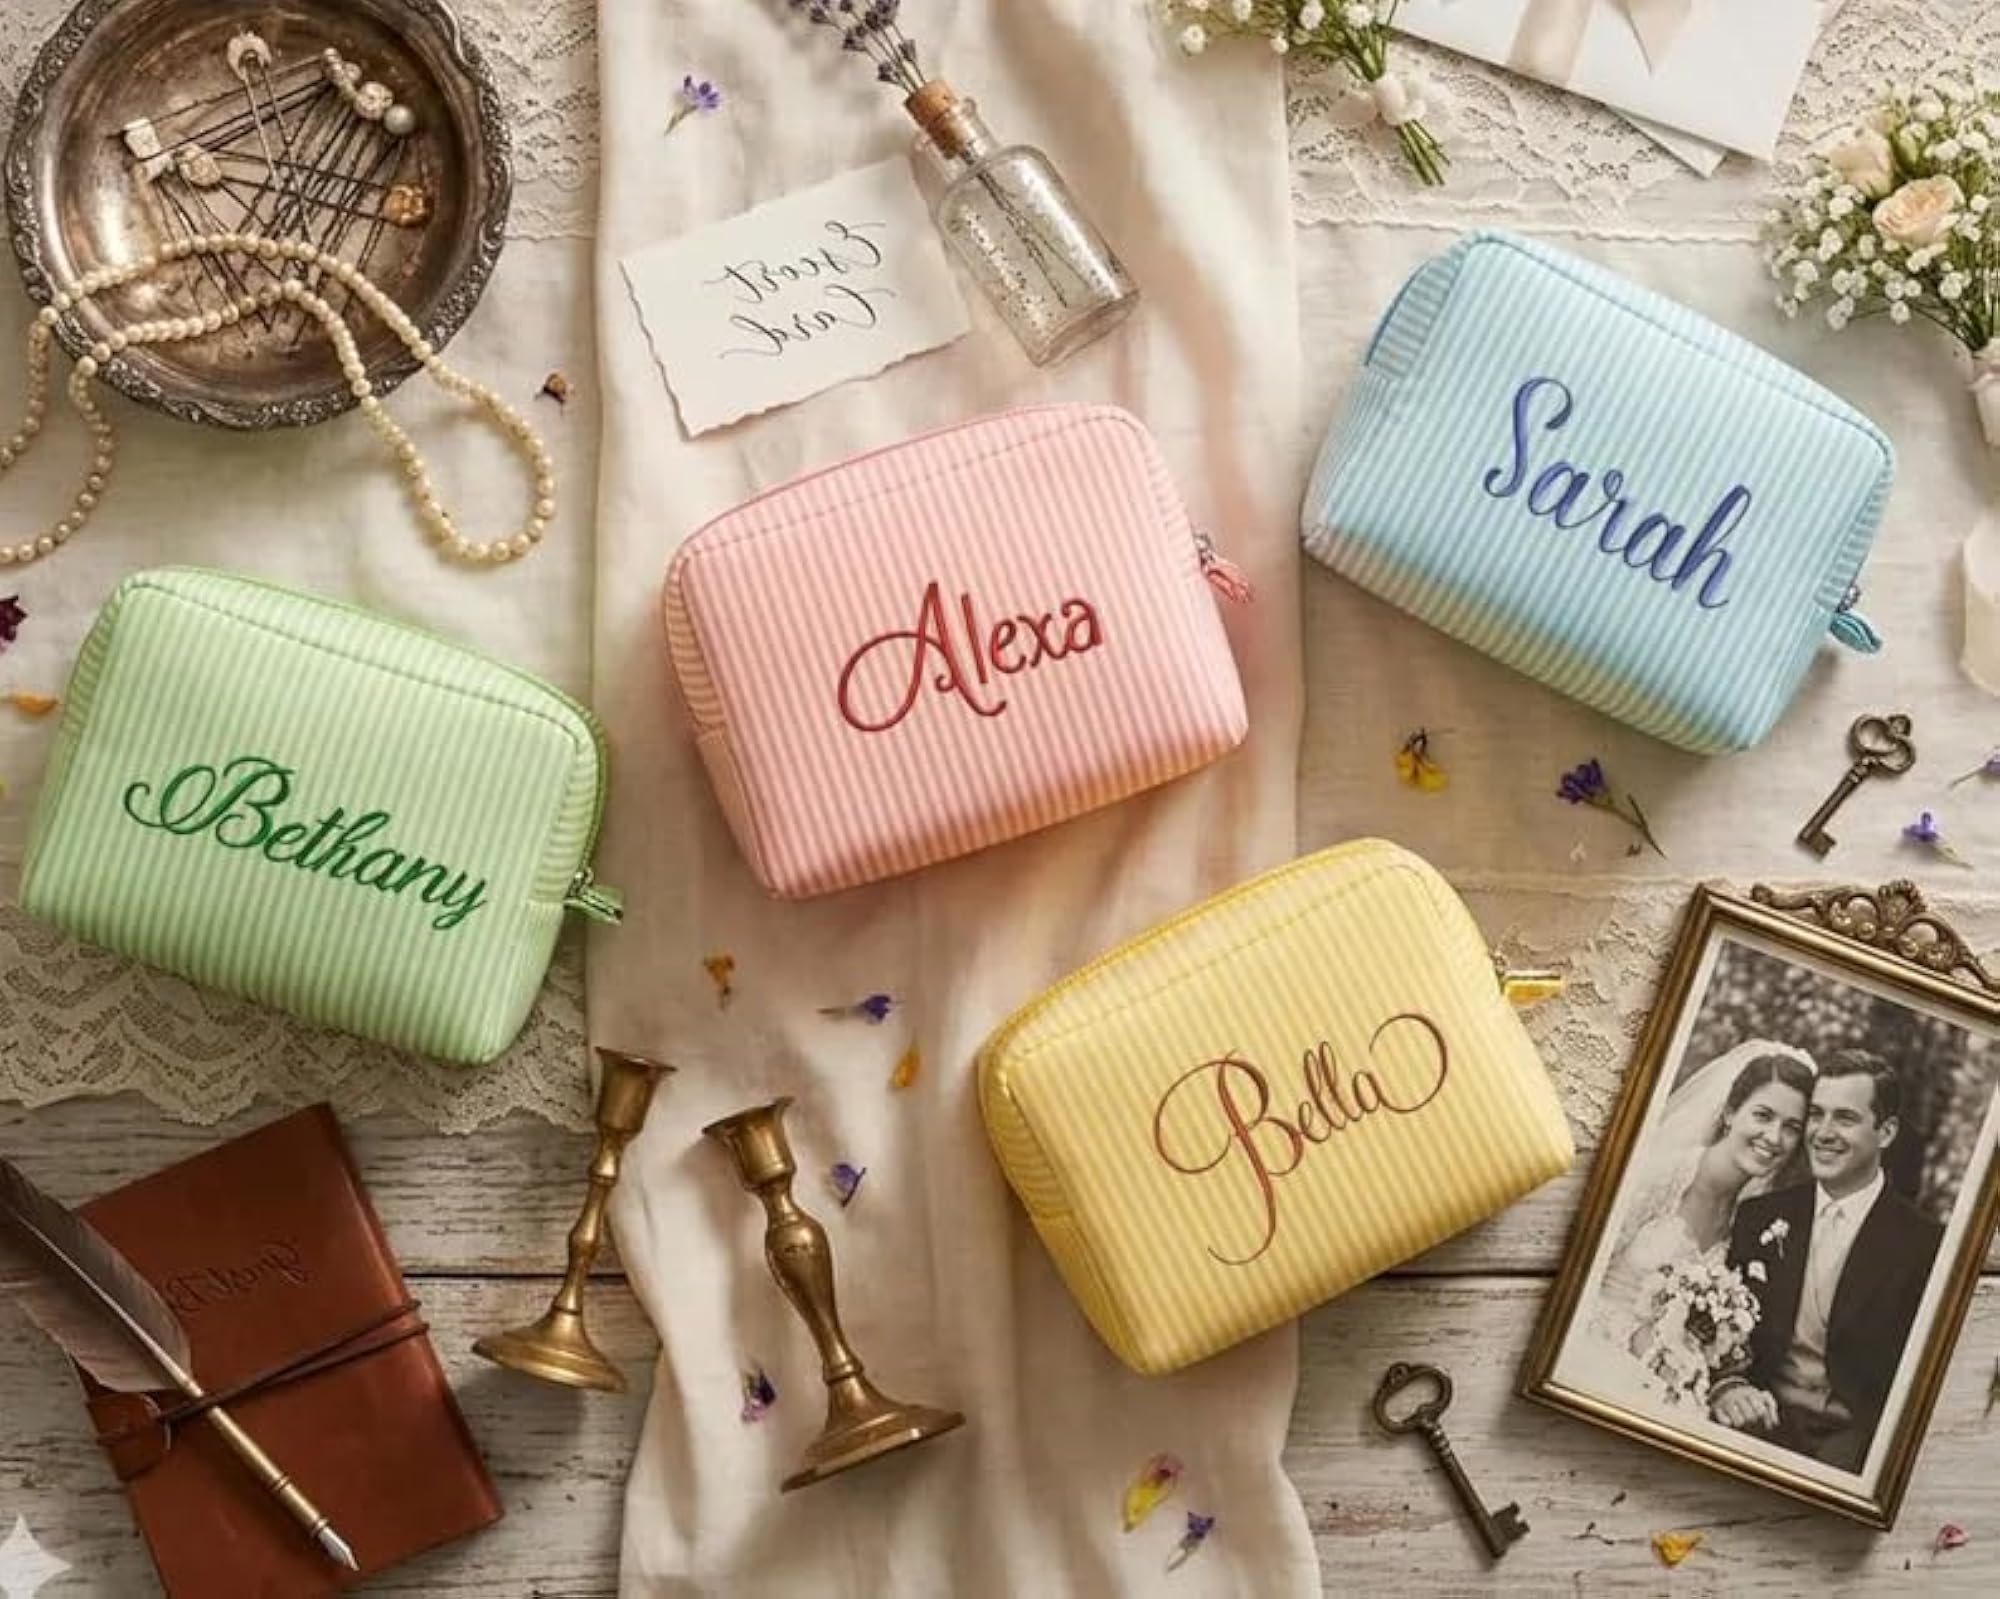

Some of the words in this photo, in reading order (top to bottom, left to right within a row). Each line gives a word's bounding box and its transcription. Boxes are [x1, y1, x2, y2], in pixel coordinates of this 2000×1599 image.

[1483, 376, 1751, 608] Sarah
[837, 580, 1102, 732] Alexa
[123, 756, 488, 930] Bethany
[1153, 1013, 1448, 1265] Bella
